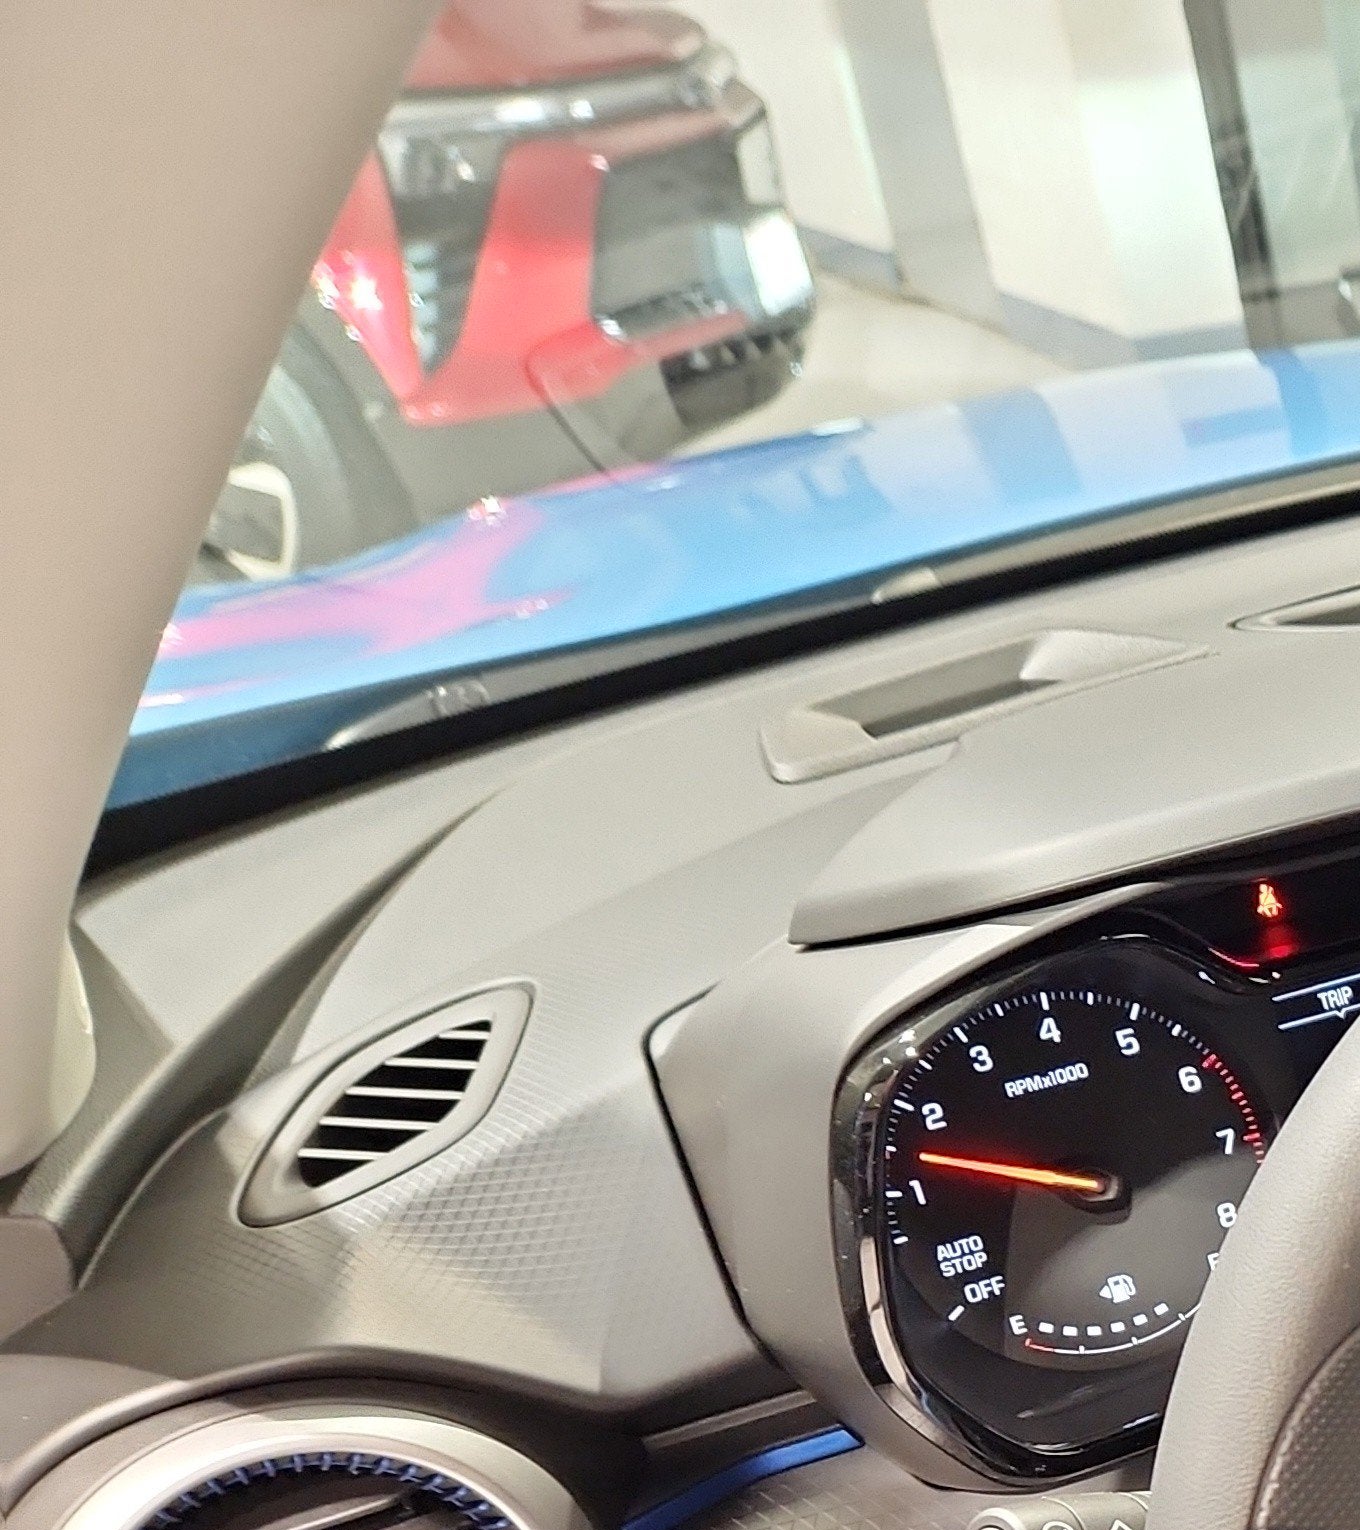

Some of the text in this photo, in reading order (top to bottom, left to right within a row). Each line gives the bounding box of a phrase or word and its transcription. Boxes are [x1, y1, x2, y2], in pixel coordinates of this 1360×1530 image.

[1315, 985, 1355, 1011] TRIP
[1037, 1016, 1063, 1044] 4
[1114, 1027, 1141, 1057] 5
[967, 1044, 995, 1074] 3
[1004, 1062, 1089, 1098] RPMx1000
[1177, 1065, 1203, 1094] 6
[920, 1102, 948, 1131] 2
[1214, 1127, 1238, 1155] 7
[907, 1178, 928, 1206] 1
[1215, 1200, 1238, 1229] 8
[935, 1234, 985, 1262] AUTO
[938, 1250, 989, 1278] STOP
[962, 1275, 1007, 1303] OFF
[1007, 1313, 1029, 1336] E
